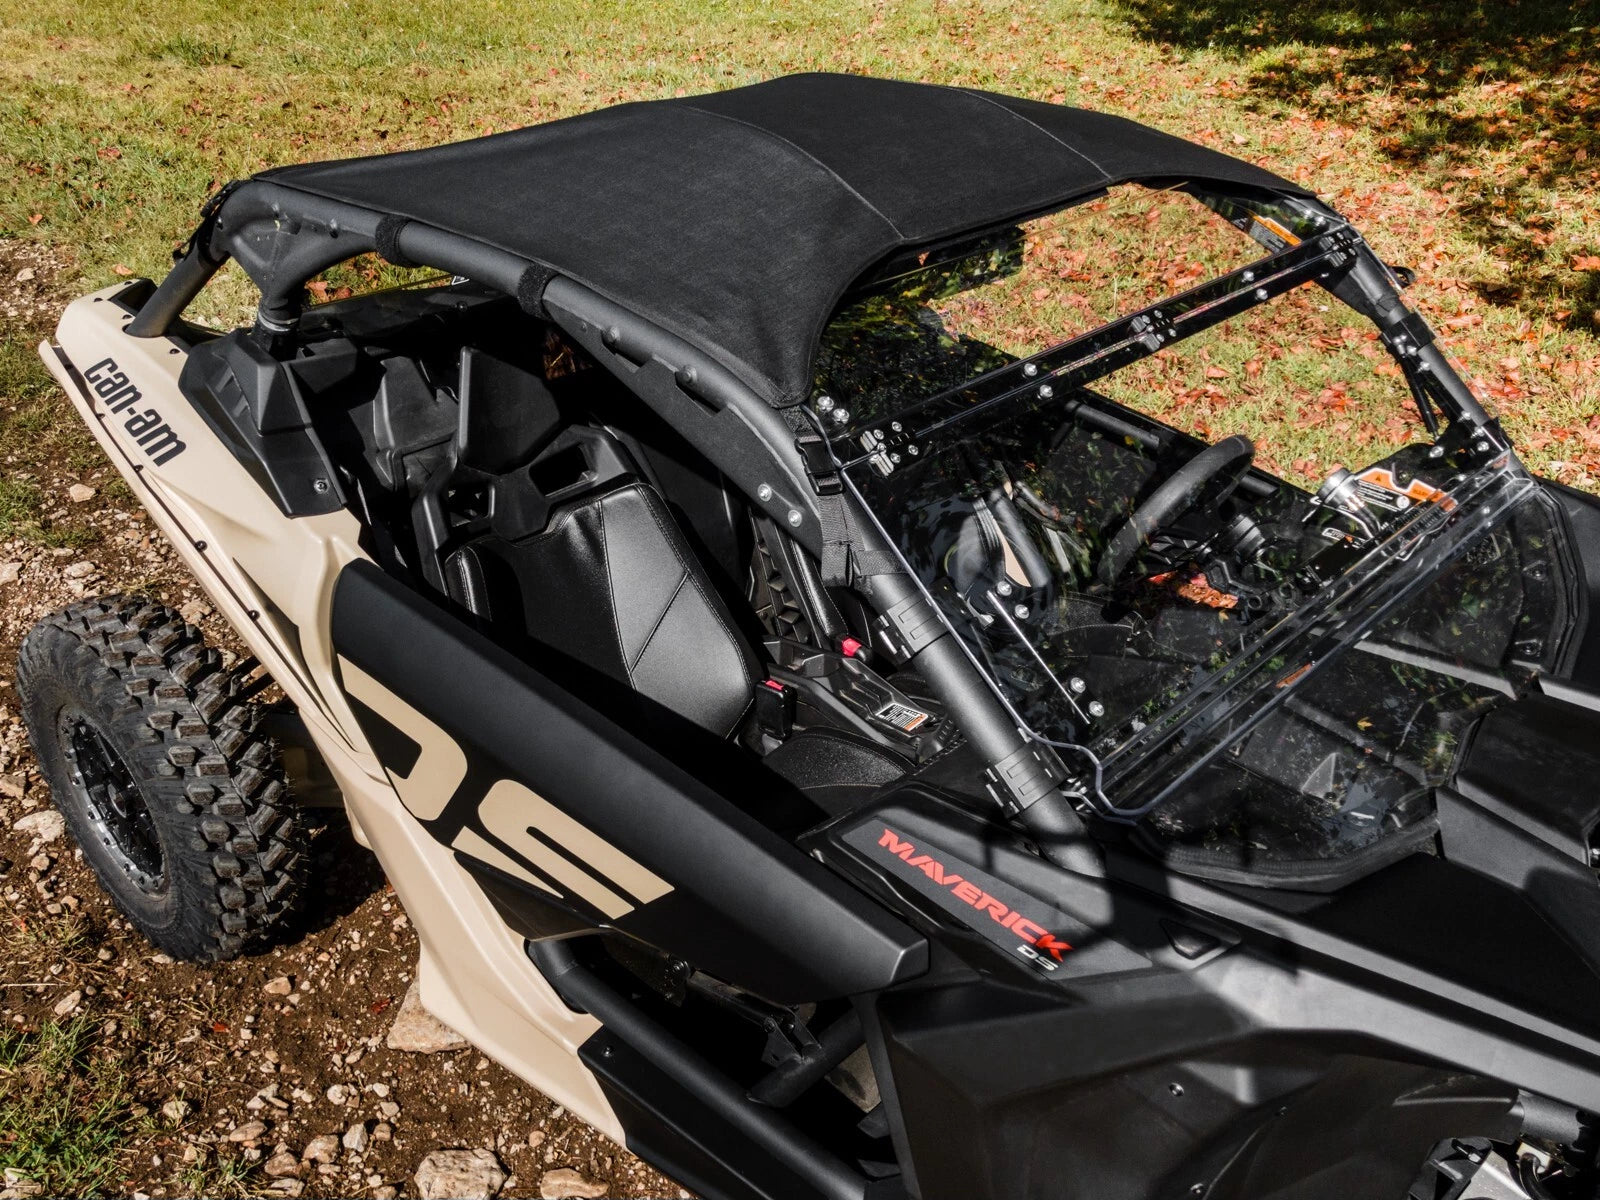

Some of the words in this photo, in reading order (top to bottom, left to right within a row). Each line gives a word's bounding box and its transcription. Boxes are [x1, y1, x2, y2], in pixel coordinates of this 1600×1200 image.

[84, 357, 187, 467] can-am
[878, 829, 1073, 962] MAVERICK
[1017, 944, 1059, 971] DS
